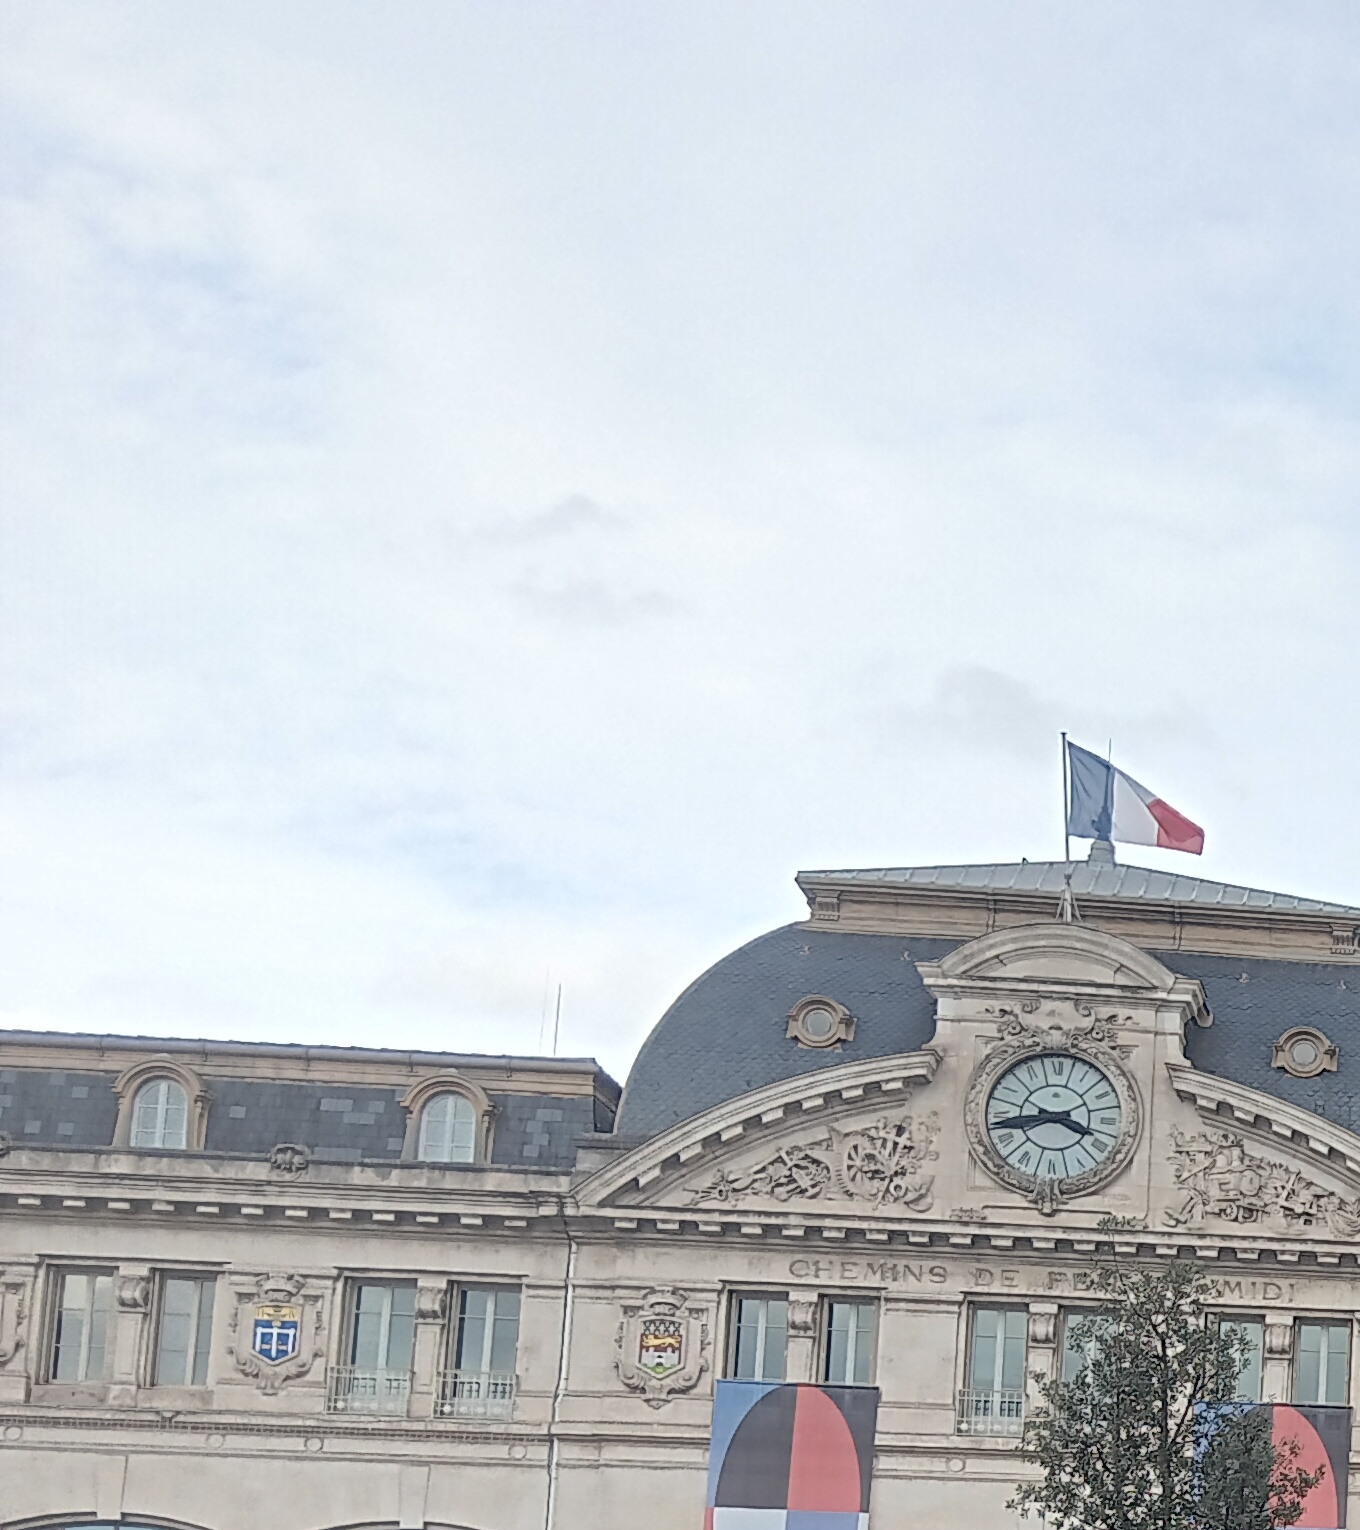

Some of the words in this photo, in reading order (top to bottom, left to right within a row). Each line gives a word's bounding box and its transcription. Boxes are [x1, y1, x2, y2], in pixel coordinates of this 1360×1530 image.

[788, 1258, 948, 1285] CHEMINS
[973, 1267, 1020, 1289] DE
[1221, 1280, 1296, 1303] MIDI
